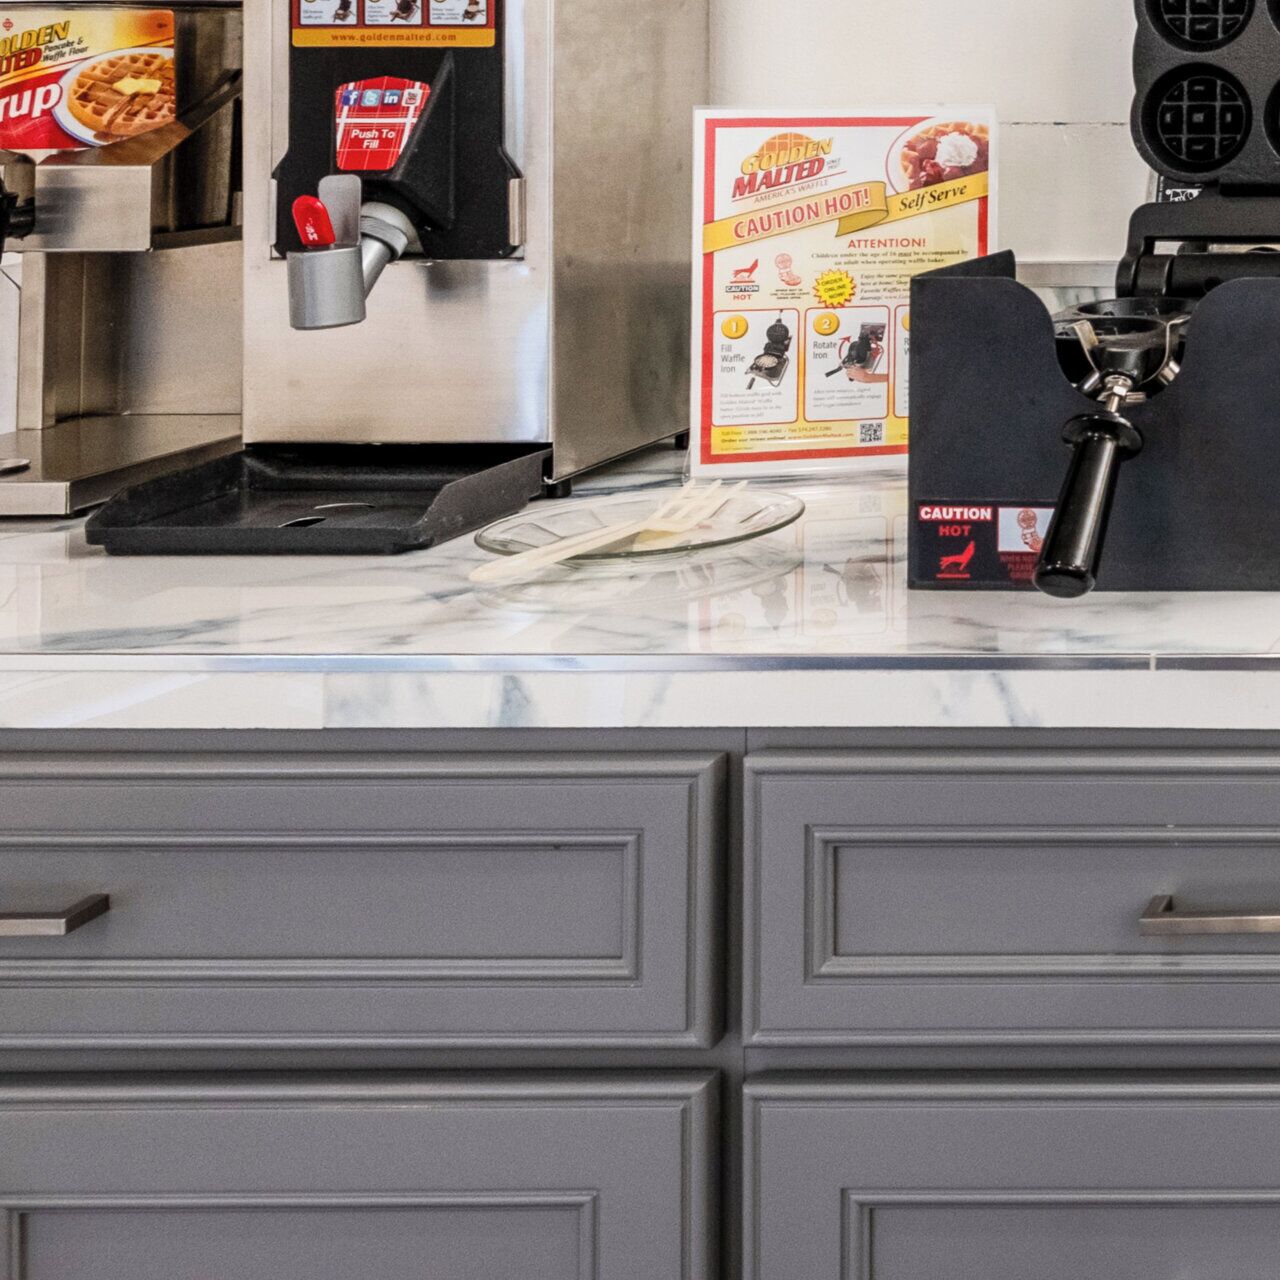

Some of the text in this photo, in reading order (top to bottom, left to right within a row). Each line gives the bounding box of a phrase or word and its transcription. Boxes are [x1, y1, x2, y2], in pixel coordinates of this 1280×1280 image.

[331, 33, 457, 42] www.goldenmalted.com
[44, 36, 84, 53] Pancake &
[43, 46, 89, 62] Waffle Flour
[351, 129, 396, 139] Push To
[363, 140, 379, 149] Fill
[741, 137, 834, 175] GOLDEN
[732, 157, 825, 198] MALTED
[754, 180, 829, 204] AMERICA'S WAFFLE
[899, 184, 968, 212] Self Serve
[734, 188, 871, 238] CAUTION HOT!
[848, 238, 926, 249] ATTENTION!
[821, 277, 843, 287] ORDER
[824, 284, 846, 293] ONLINE
[829, 292, 845, 300] NOW!
[731, 321, 737, 332] 1
[823, 318, 831, 329] 2
[721, 344, 732, 352] Fill
[813, 341, 837, 350] Rotate
[721, 354, 746, 363] Waffle
[813, 352, 828, 360] Iron
[721, 365, 736, 373] Iron
[920, 507, 992, 520] CAUTION
[938, 525, 971, 537] HOT
